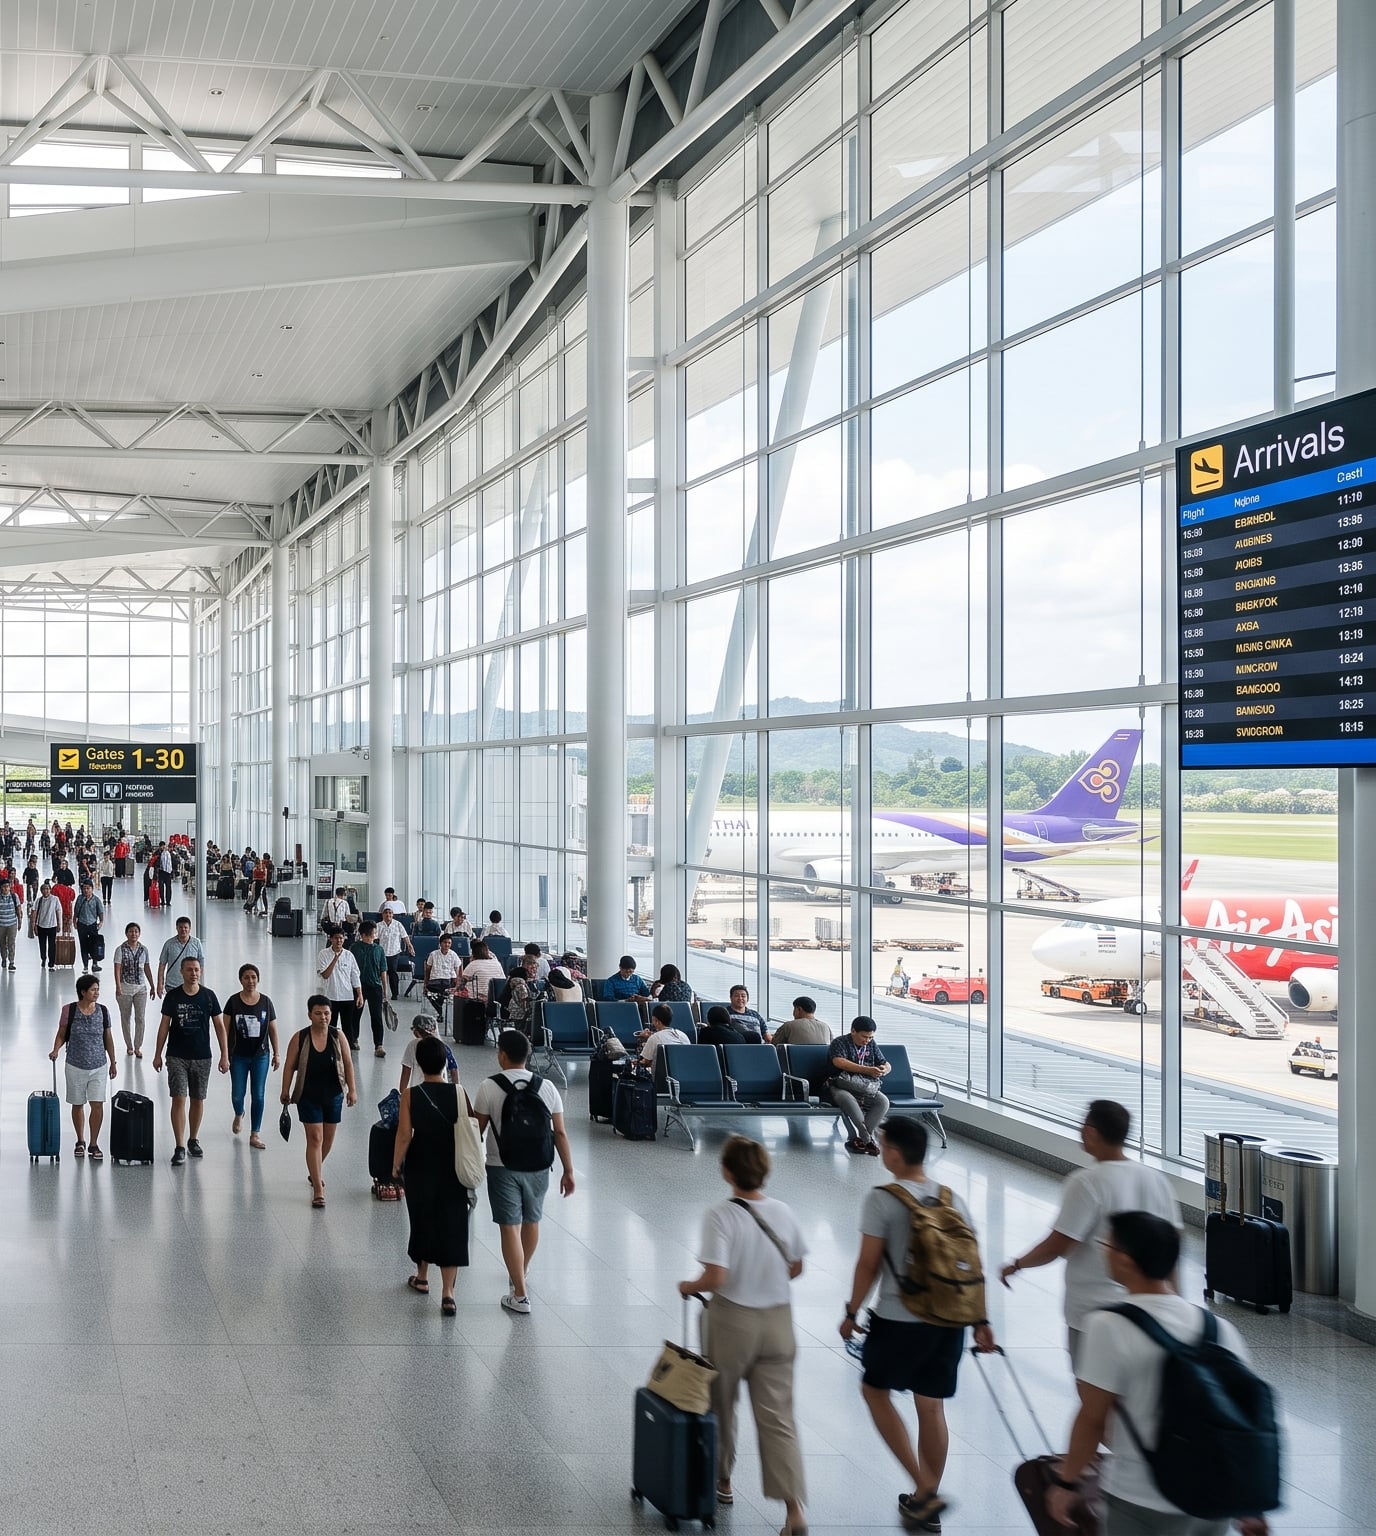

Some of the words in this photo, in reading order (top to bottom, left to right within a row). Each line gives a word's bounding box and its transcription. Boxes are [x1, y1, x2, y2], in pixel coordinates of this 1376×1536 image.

[1233, 421, 1346, 478] Arrivals
[85, 747, 125, 760] Gates
[131, 748, 185, 770] 1-30
[713, 819, 751, 830] THAI
